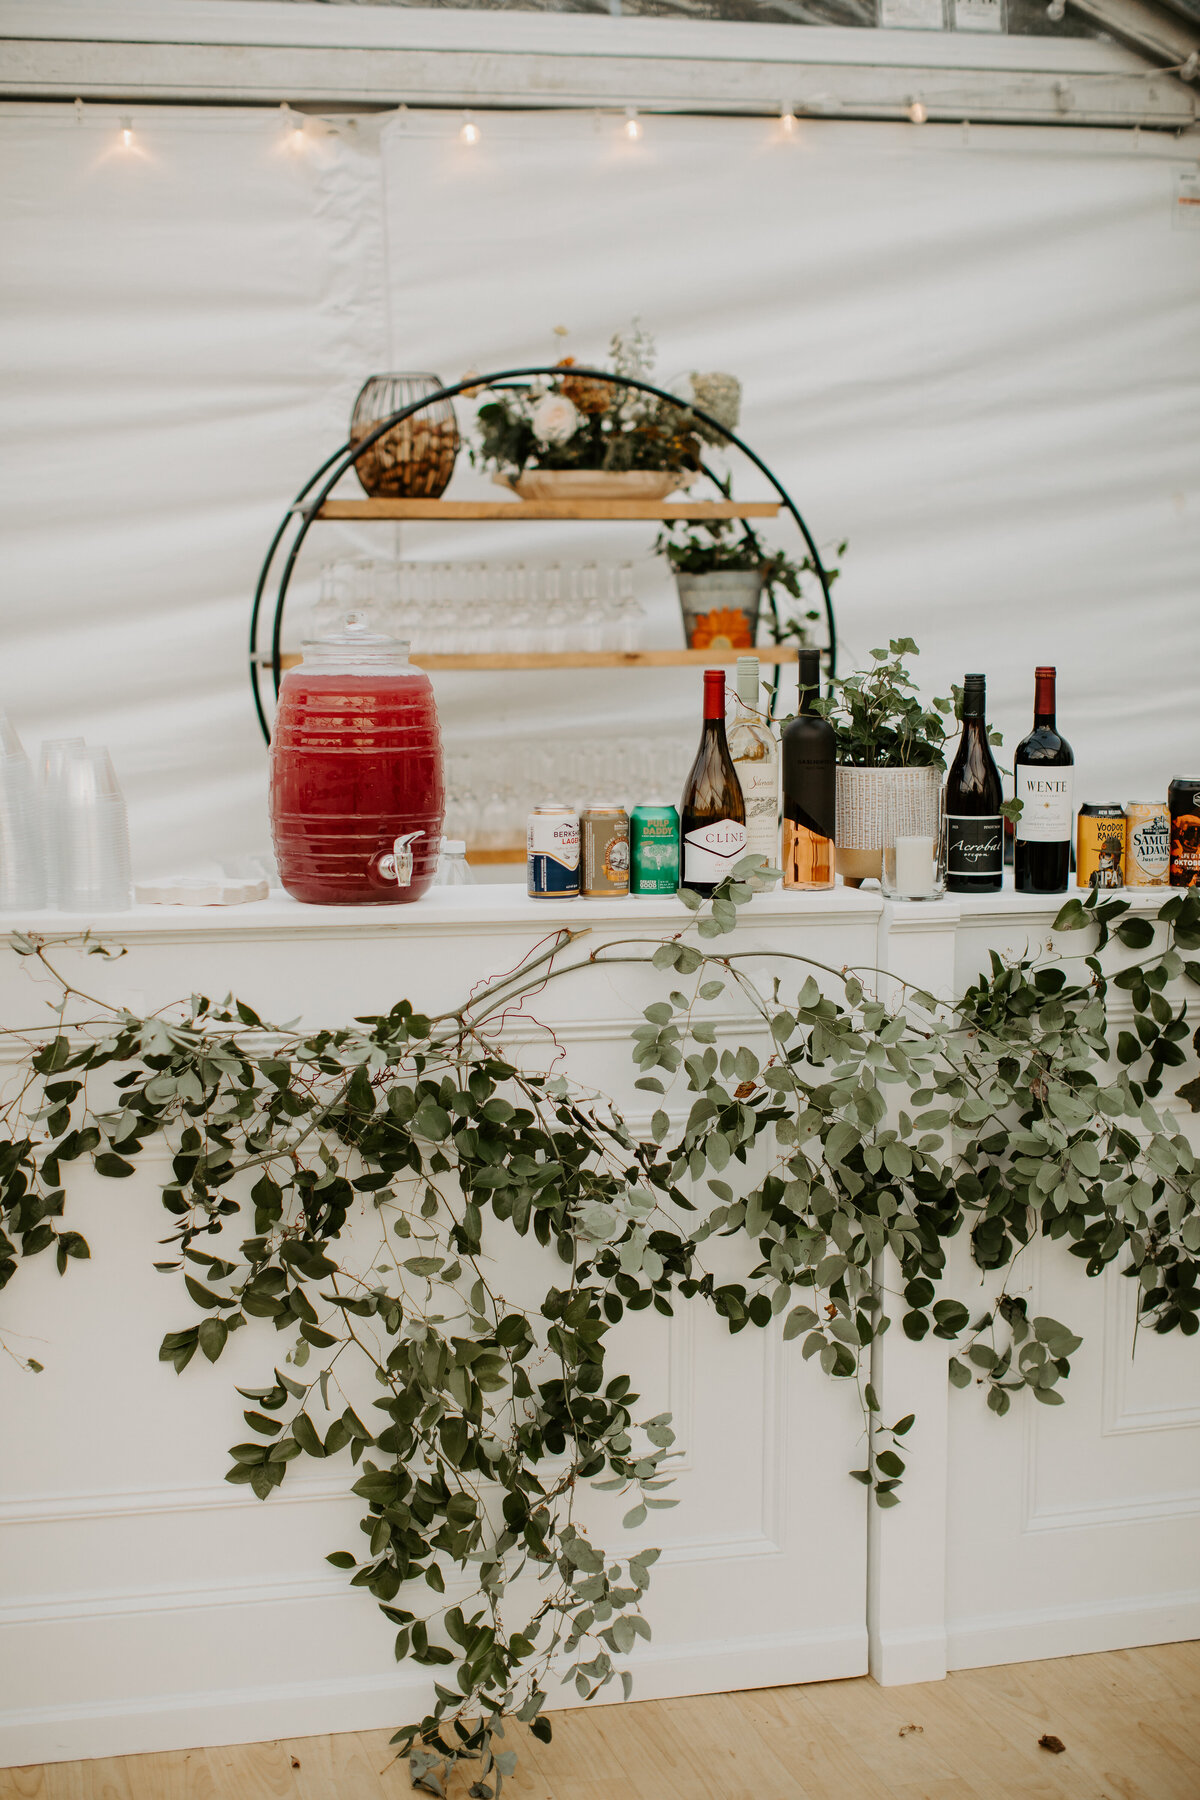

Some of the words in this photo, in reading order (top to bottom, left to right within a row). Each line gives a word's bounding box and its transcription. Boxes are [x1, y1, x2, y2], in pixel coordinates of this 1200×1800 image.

[1026, 780, 1067, 792] WENTE
[647, 819, 669, 827] PULP
[1096, 822, 1123, 831] VOODOO
[643, 827, 673, 835] DADDY
[705, 832, 744, 843] CLINE
[1133, 833, 1169, 846] SAMUE
[1100, 871, 1118, 885] IPA
